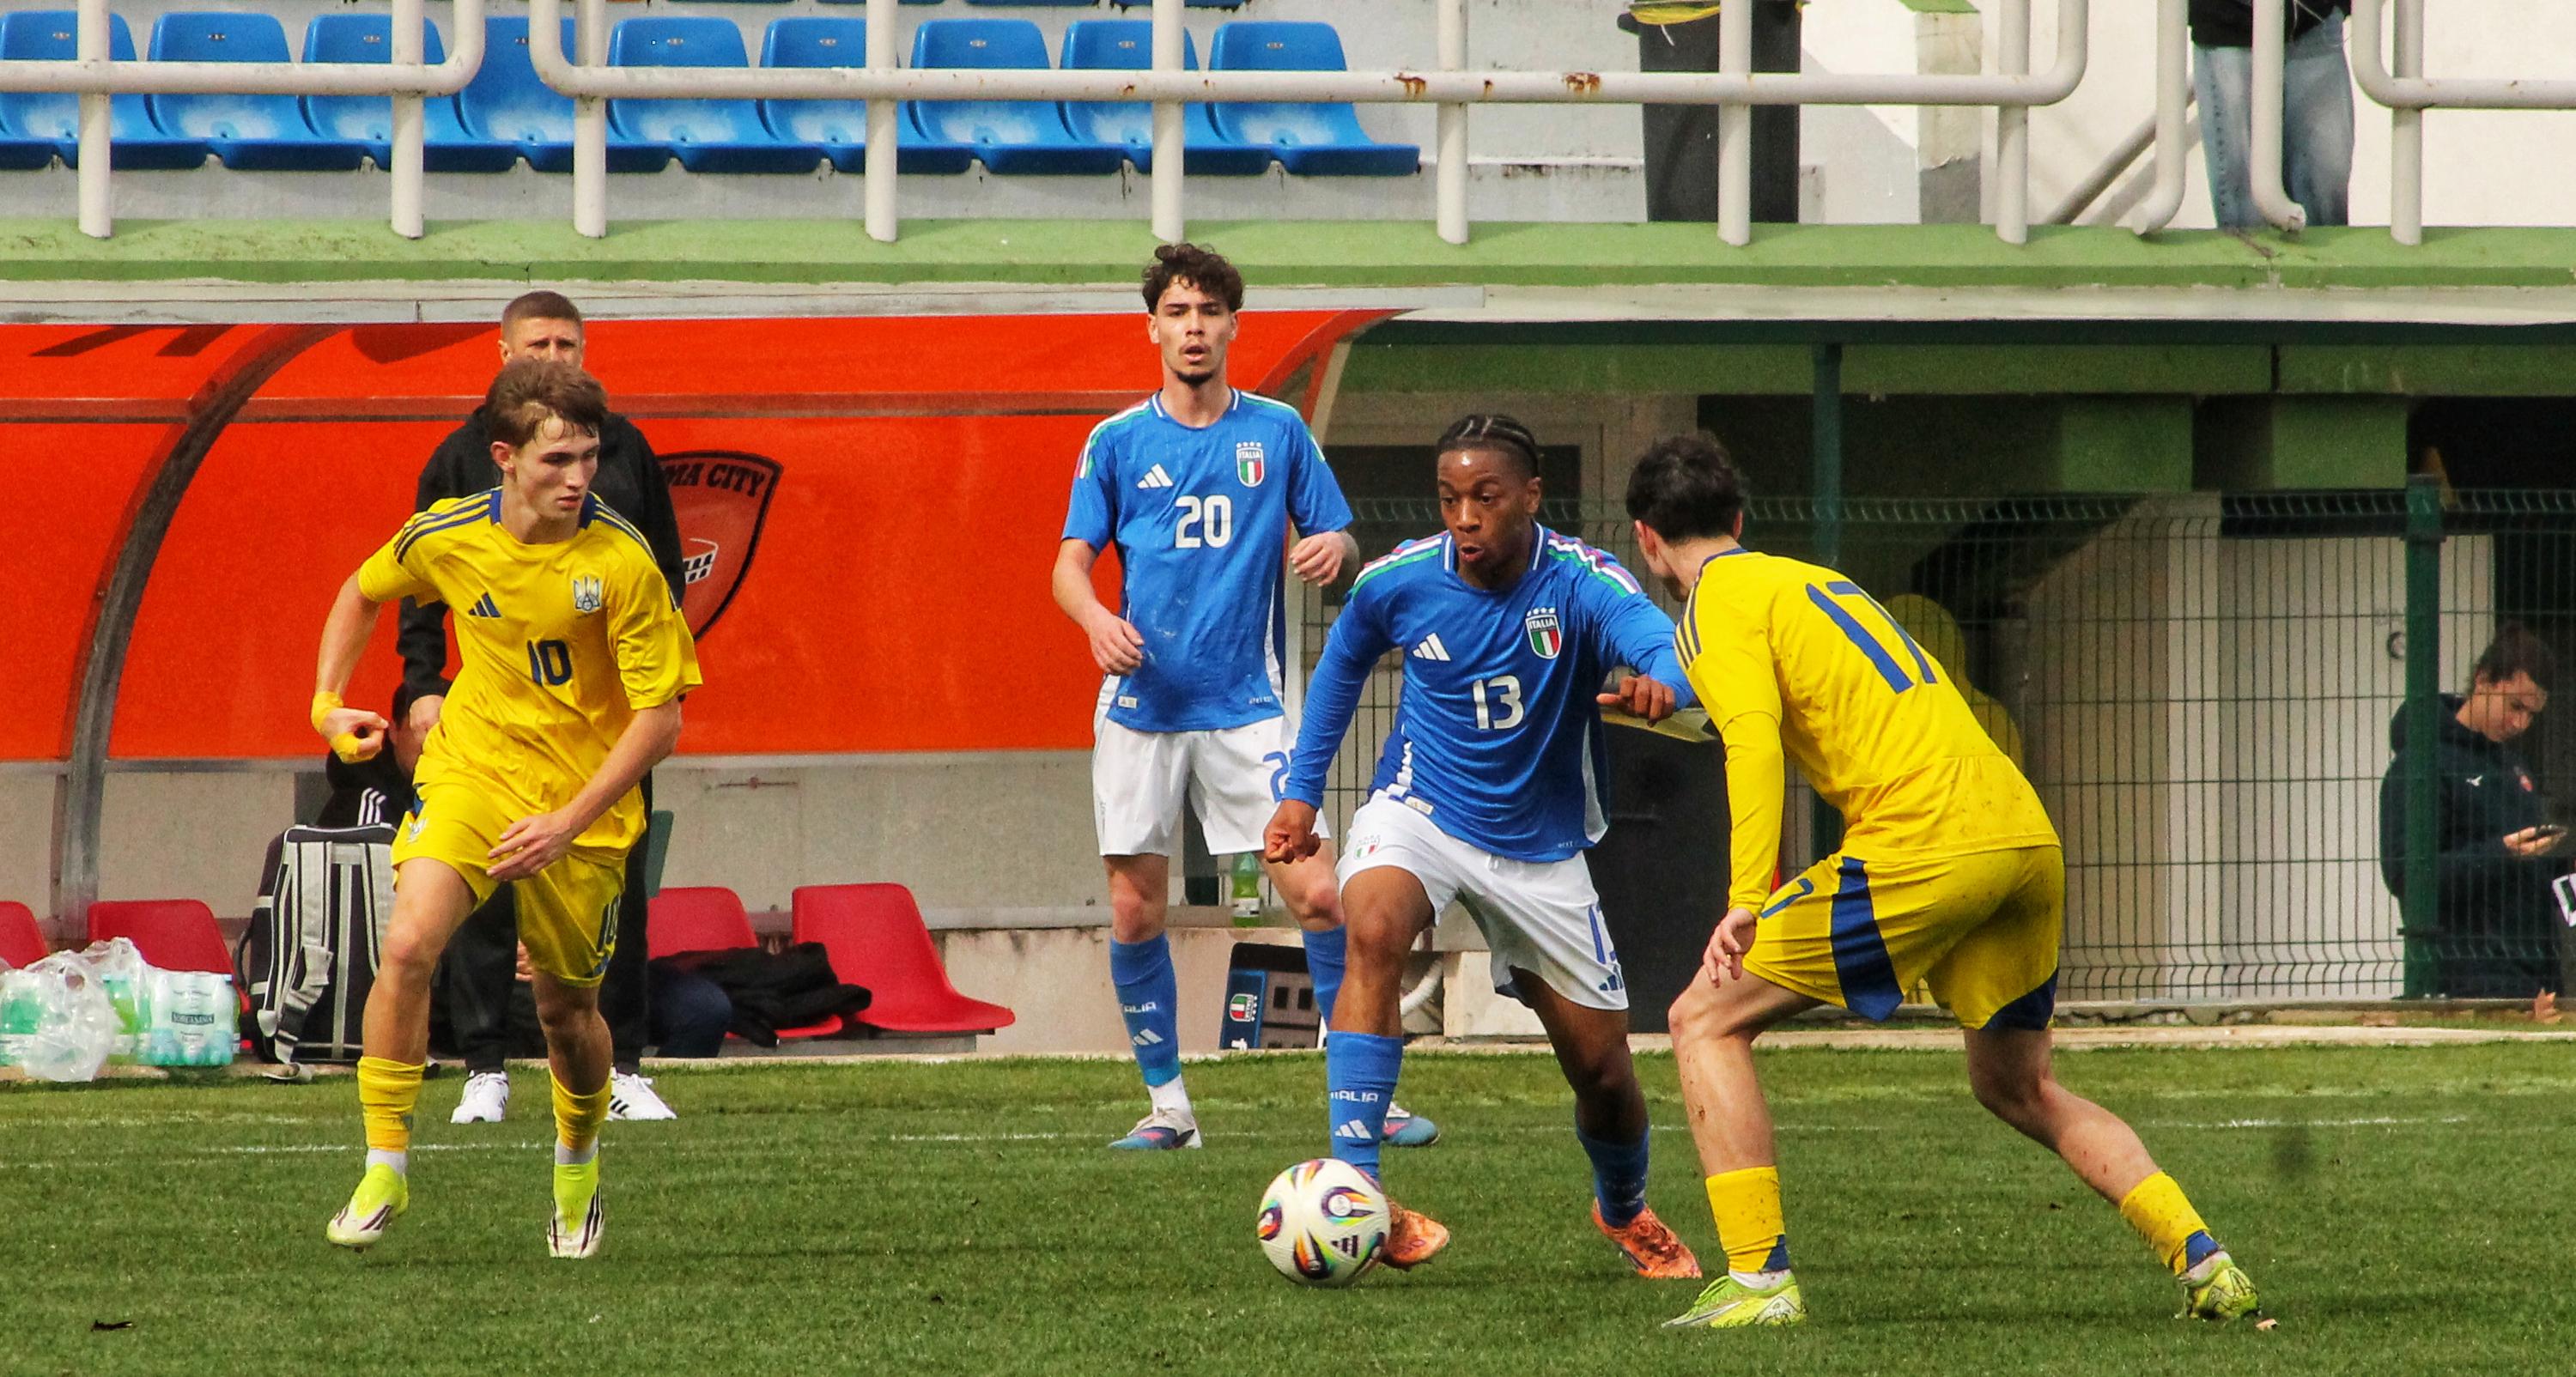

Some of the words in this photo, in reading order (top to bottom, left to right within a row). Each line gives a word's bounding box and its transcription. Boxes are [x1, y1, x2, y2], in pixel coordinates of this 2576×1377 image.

[663, 463, 705, 487] MA
[707, 463, 766, 498] CITY
[1239, 451, 1261, 459] ITALIA
[1175, 494, 1231, 549] 20
[1528, 617, 1556, 630] ITALIA
[1805, 580, 1938, 695] 17
[526, 639, 573, 688] 10
[1473, 675, 1524, 730] 13
[1262, 750, 1291, 803] 2
[1588, 901, 1617, 965] 1
[1121, 1001, 1157, 1013] ALIA
